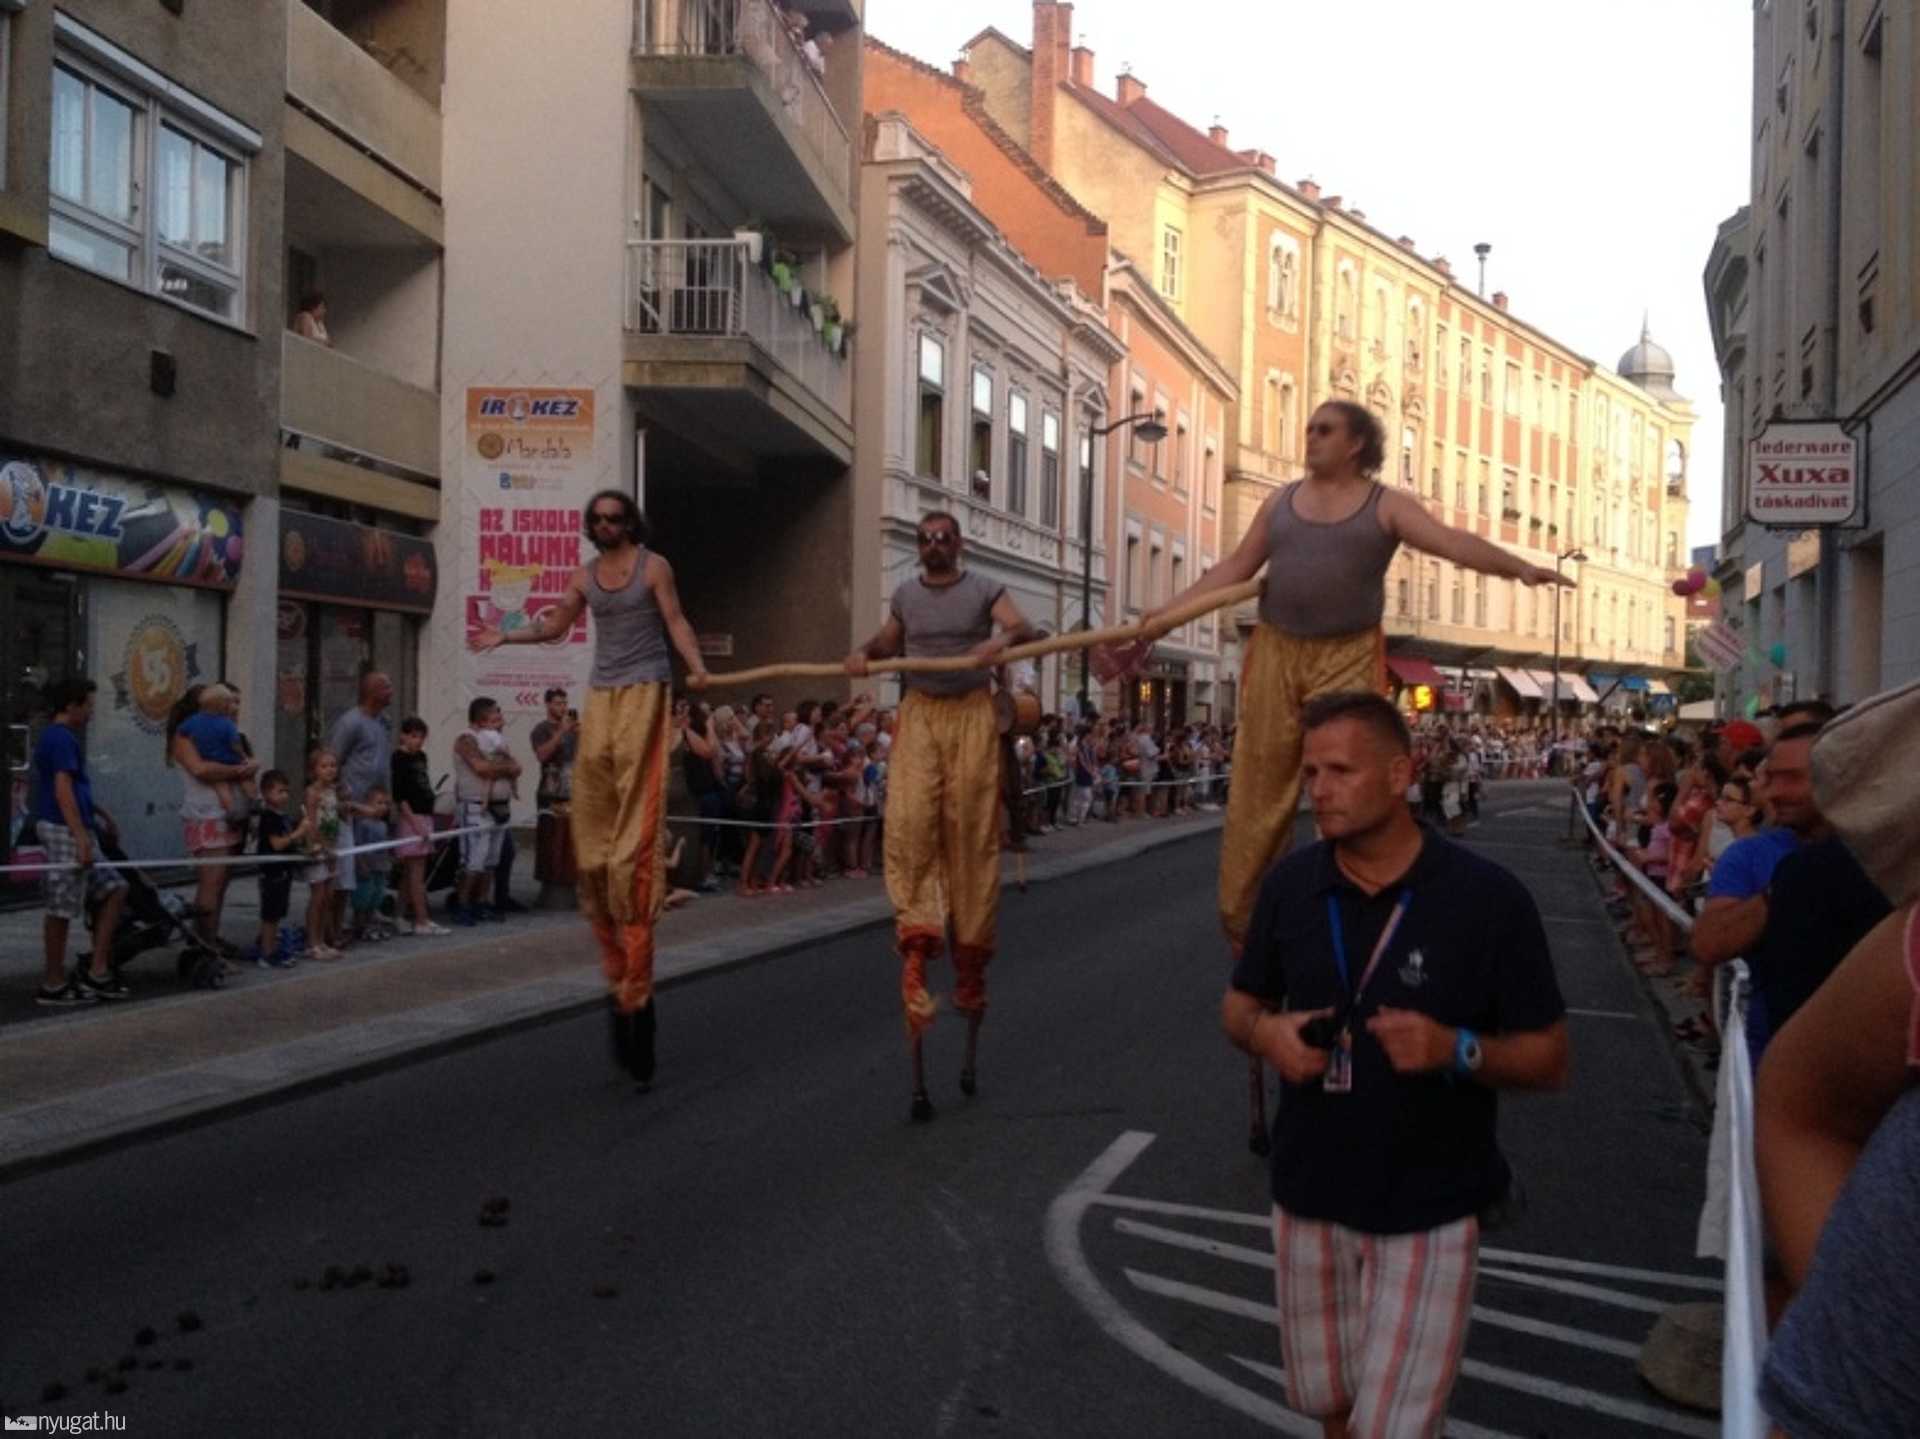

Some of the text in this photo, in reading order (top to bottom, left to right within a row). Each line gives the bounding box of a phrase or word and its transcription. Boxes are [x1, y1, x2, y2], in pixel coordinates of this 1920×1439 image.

[1756, 440, 1851, 454] lederware
[1757, 463, 1850, 484] Xuxa
[480, 508, 580, 533] AZ ISKOLA
